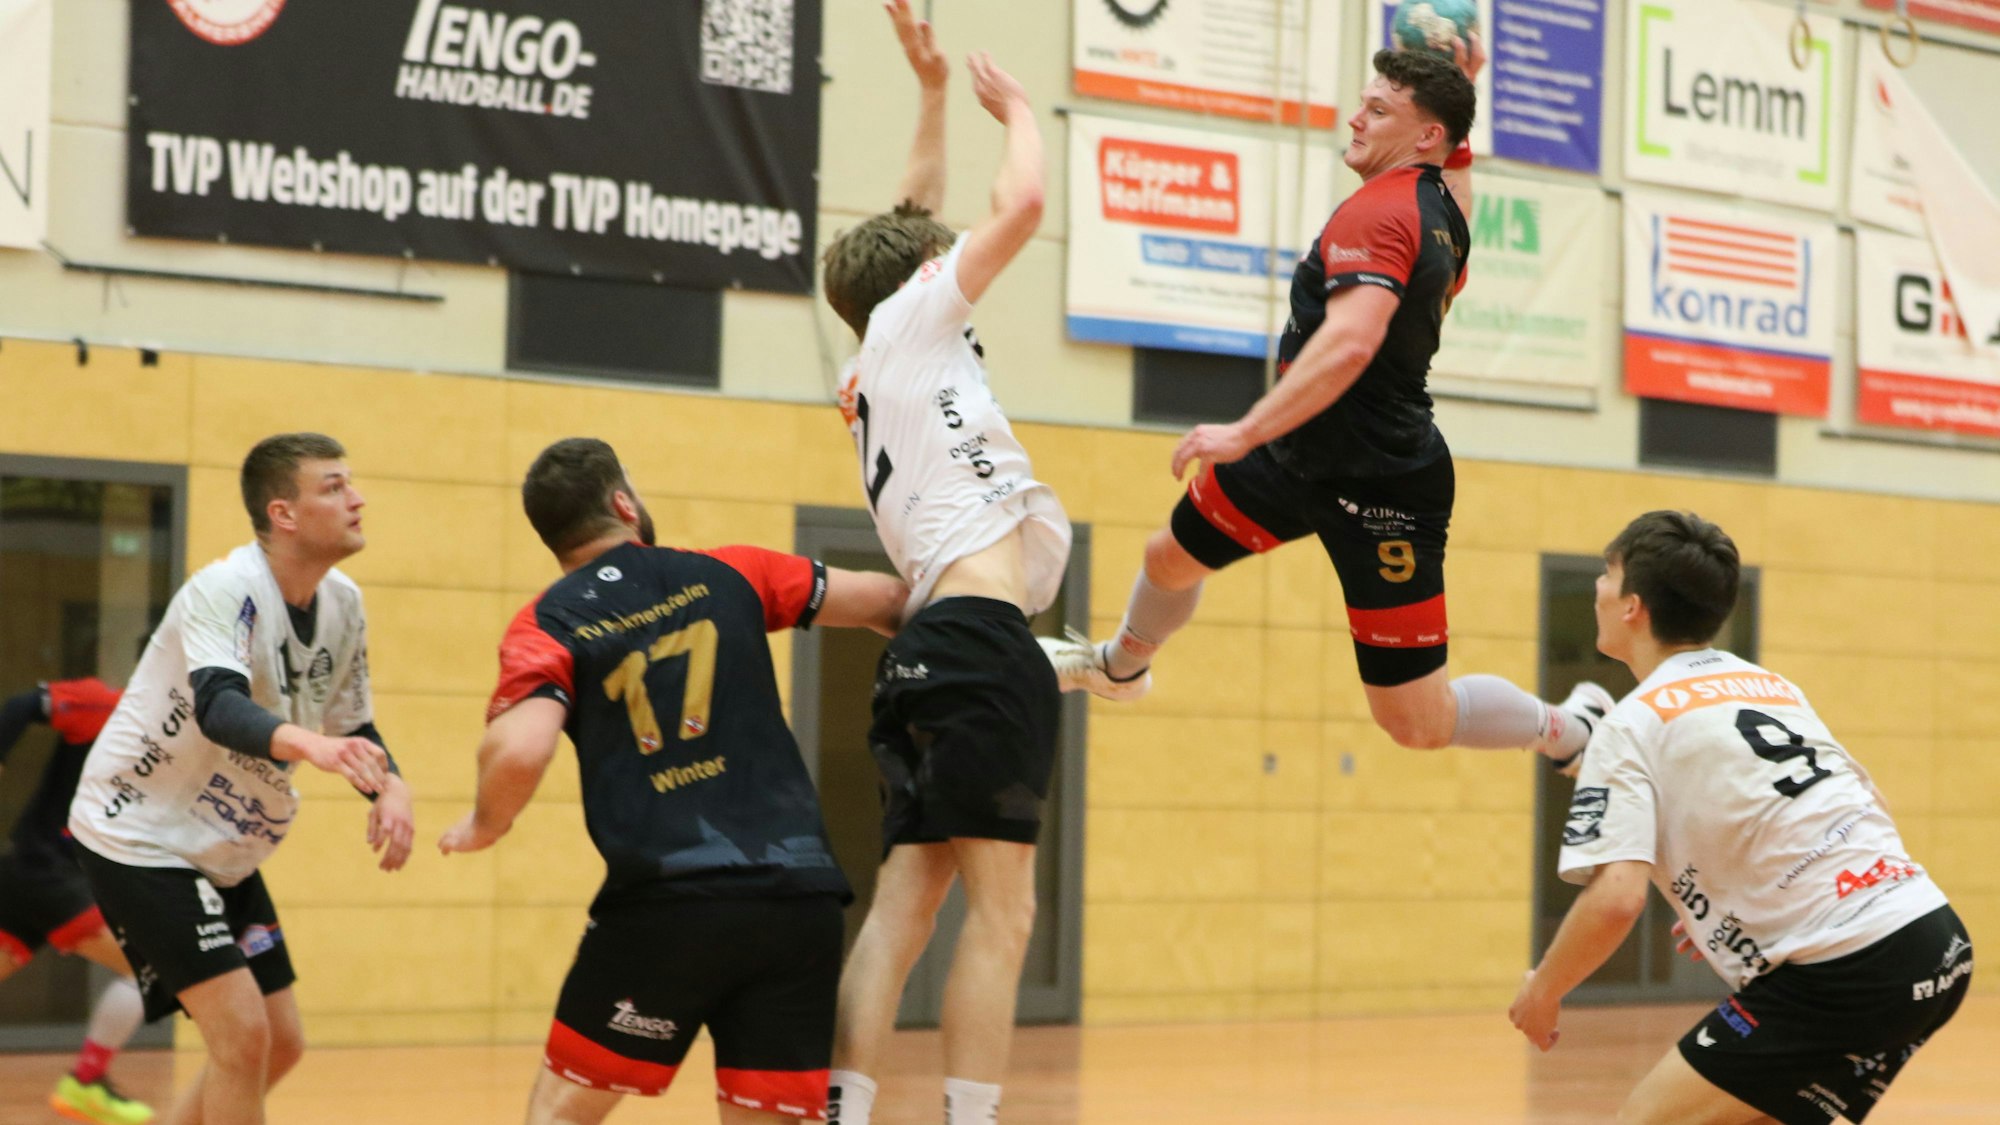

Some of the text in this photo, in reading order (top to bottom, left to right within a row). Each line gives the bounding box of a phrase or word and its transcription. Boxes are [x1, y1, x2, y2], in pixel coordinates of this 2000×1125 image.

[395, 64, 593, 120] HANDBALL.DE
[1664, 47, 1806, 140] Lemm
[1104, 149, 1234, 192] Küpper &
[147, 131, 802, 260] TVP Webshop auf der TVP Homepage
[1105, 180, 1236, 223] Hoffmann
[1651, 240, 1811, 337] konrad
[1377, 540, 1416, 583] 9
[575, 623, 604, 641] TV
[602, 618, 719, 756] 17
[650, 755, 726, 793] Winter
[1735, 708, 1832, 799] 9
[1671, 864, 1699, 894] OCK
[1707, 910, 1742, 953] DOCK
